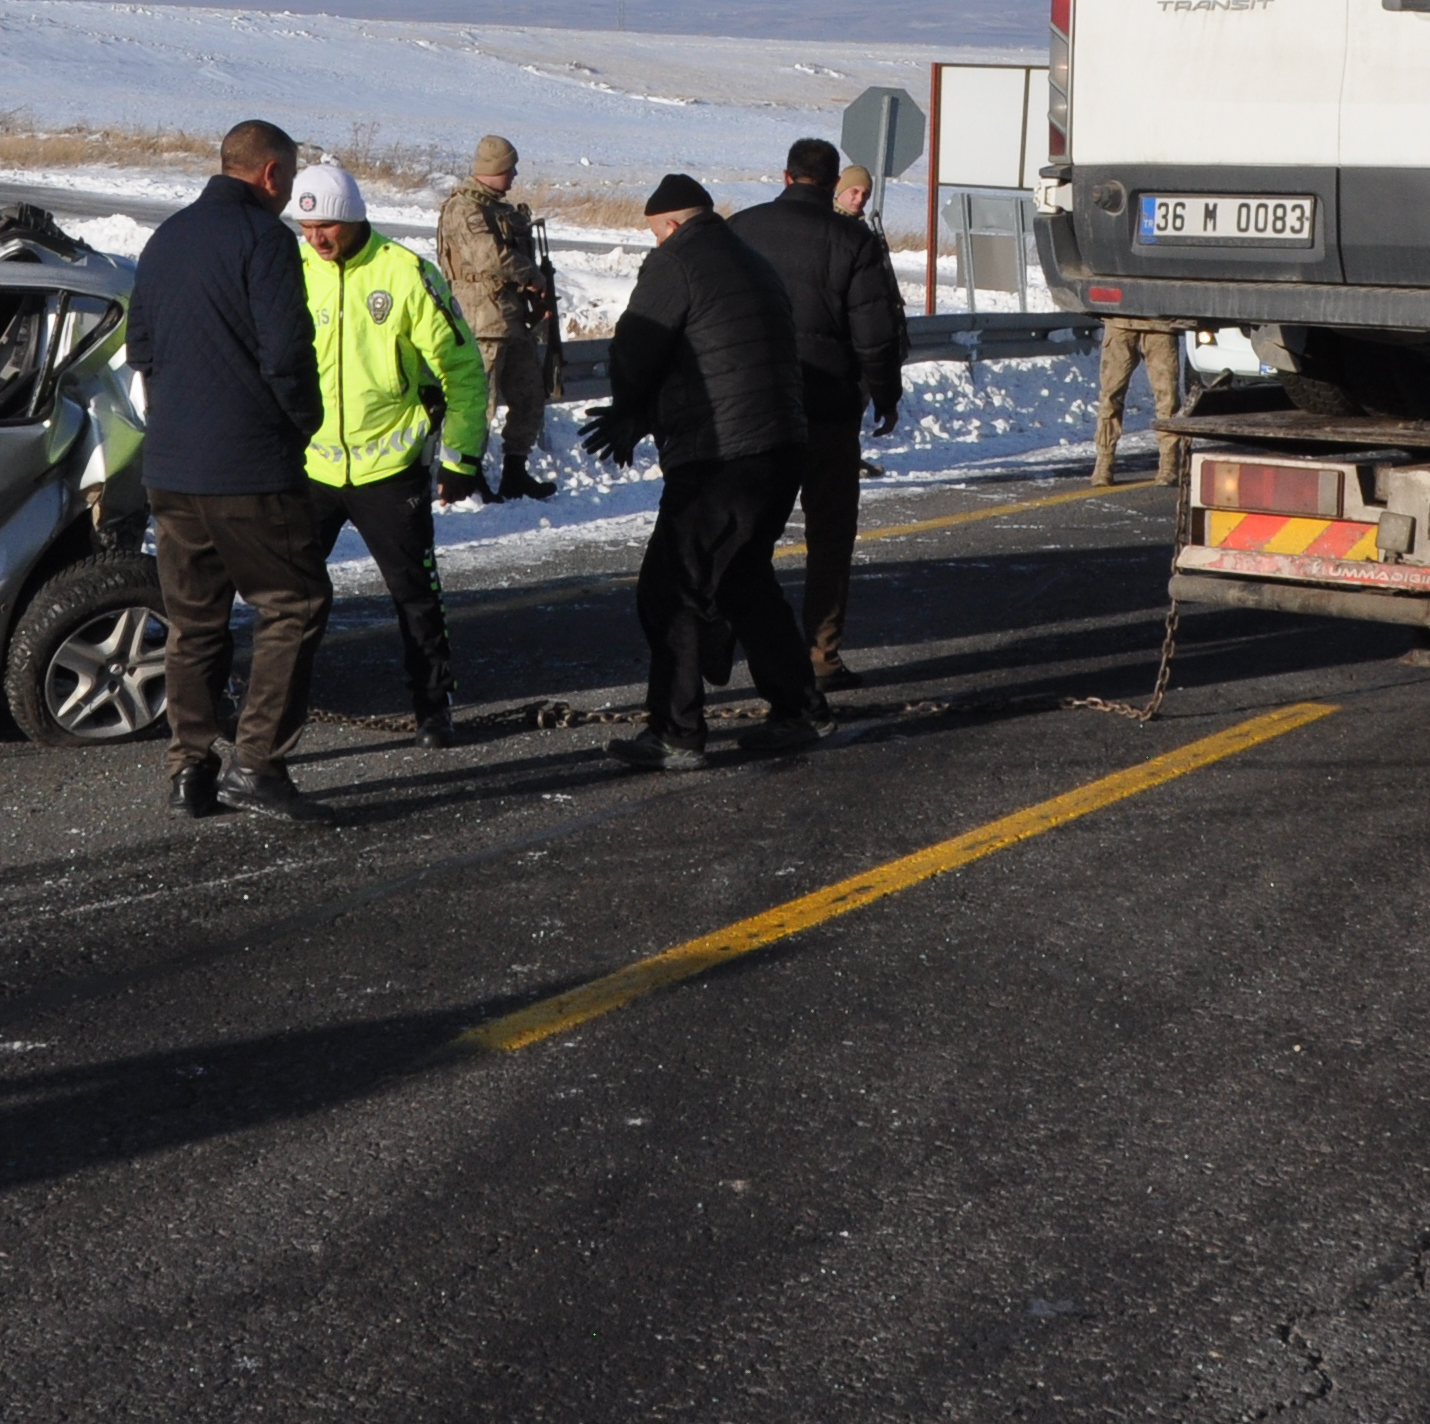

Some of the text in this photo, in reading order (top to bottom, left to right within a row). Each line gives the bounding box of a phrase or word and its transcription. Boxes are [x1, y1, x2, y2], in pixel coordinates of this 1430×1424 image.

[1155, 201, 1187, 232] 36
[1202, 202, 1218, 233] M
[1236, 202, 1307, 235] 0083
